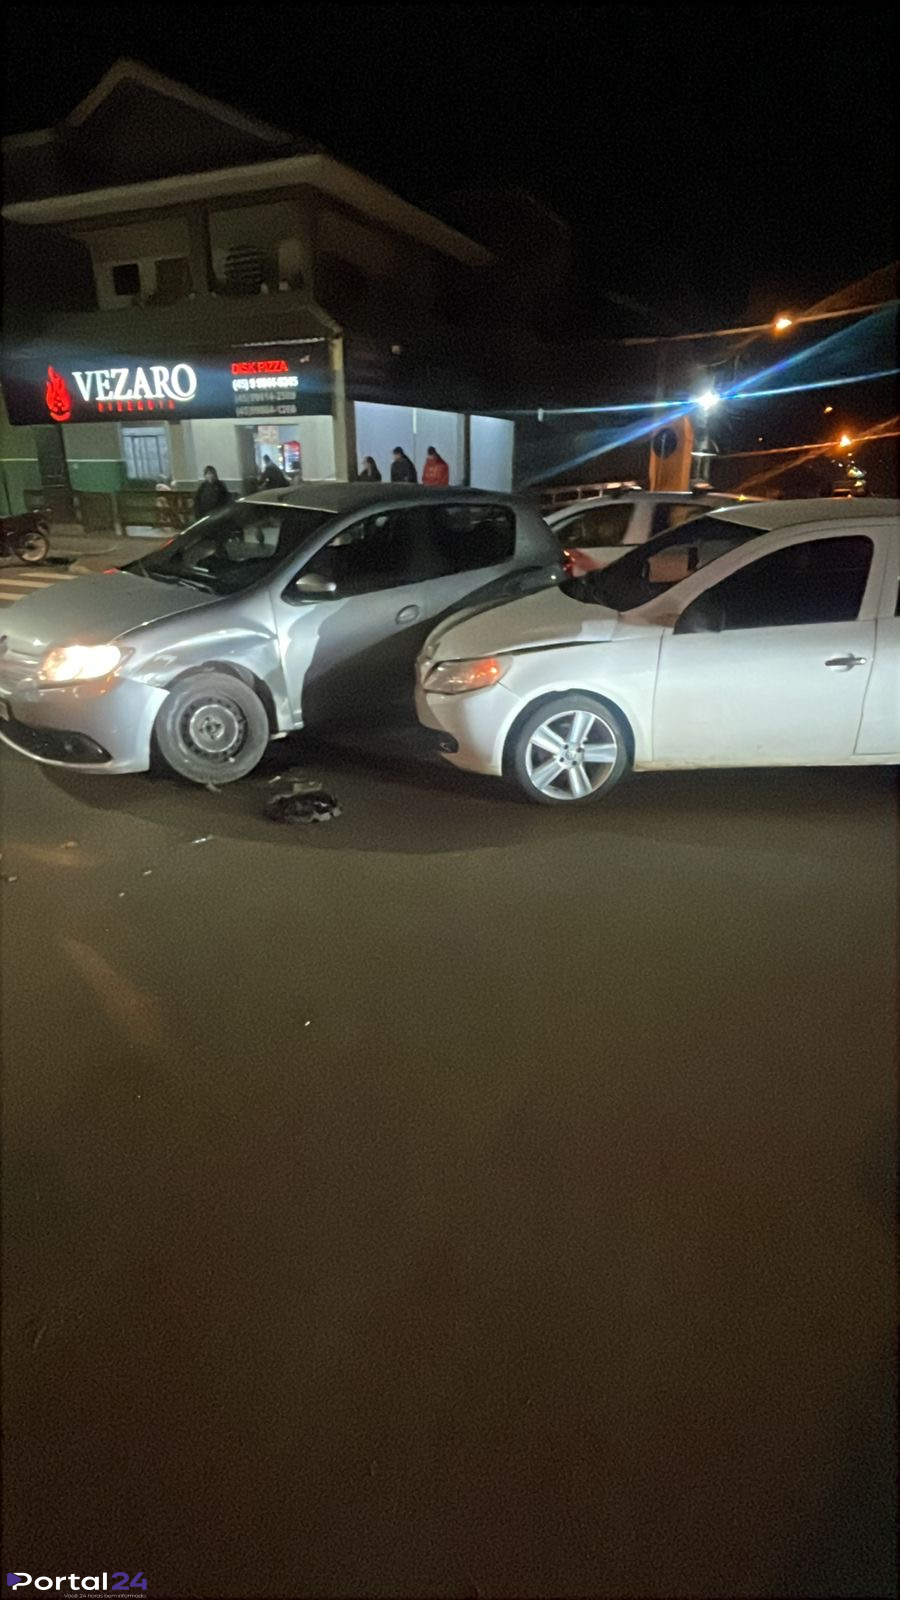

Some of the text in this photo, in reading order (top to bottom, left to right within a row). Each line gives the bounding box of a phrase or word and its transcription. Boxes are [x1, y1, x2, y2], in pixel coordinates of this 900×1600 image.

[231, 360, 288, 375] DISK PIZZA
[72, 363, 197, 402] VEZARO
